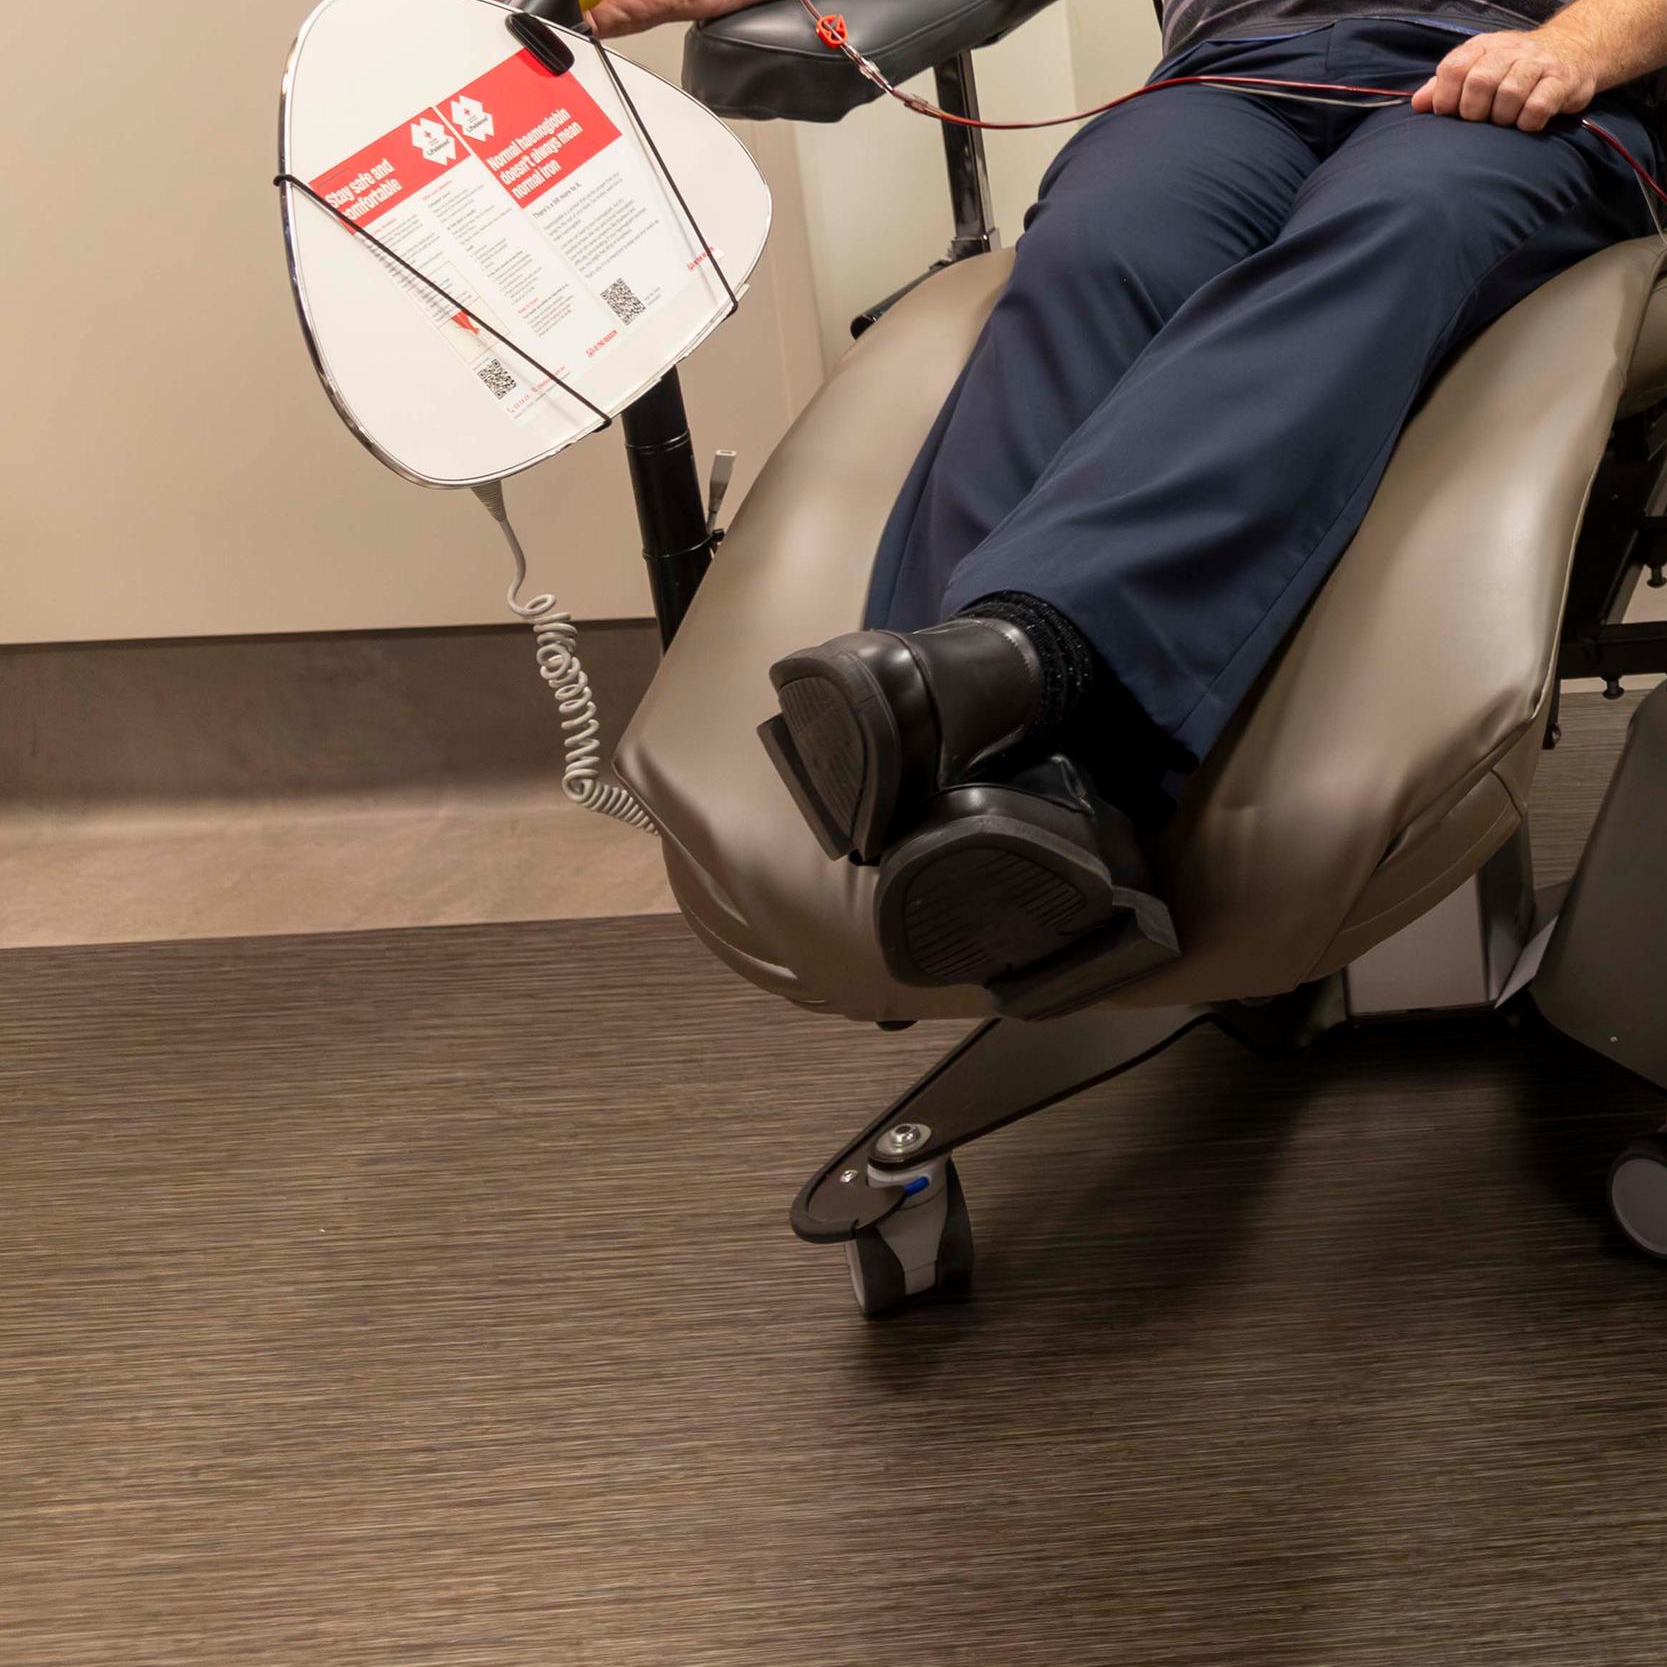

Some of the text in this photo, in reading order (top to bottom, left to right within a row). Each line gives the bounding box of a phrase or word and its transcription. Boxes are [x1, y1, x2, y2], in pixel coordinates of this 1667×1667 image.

[486, 107, 572, 172] Normal haemoglobin
[499, 121, 584, 186] doesn't always mean
[325, 157, 396, 209] Stay safe and
[511, 159, 562, 200] normal iron
